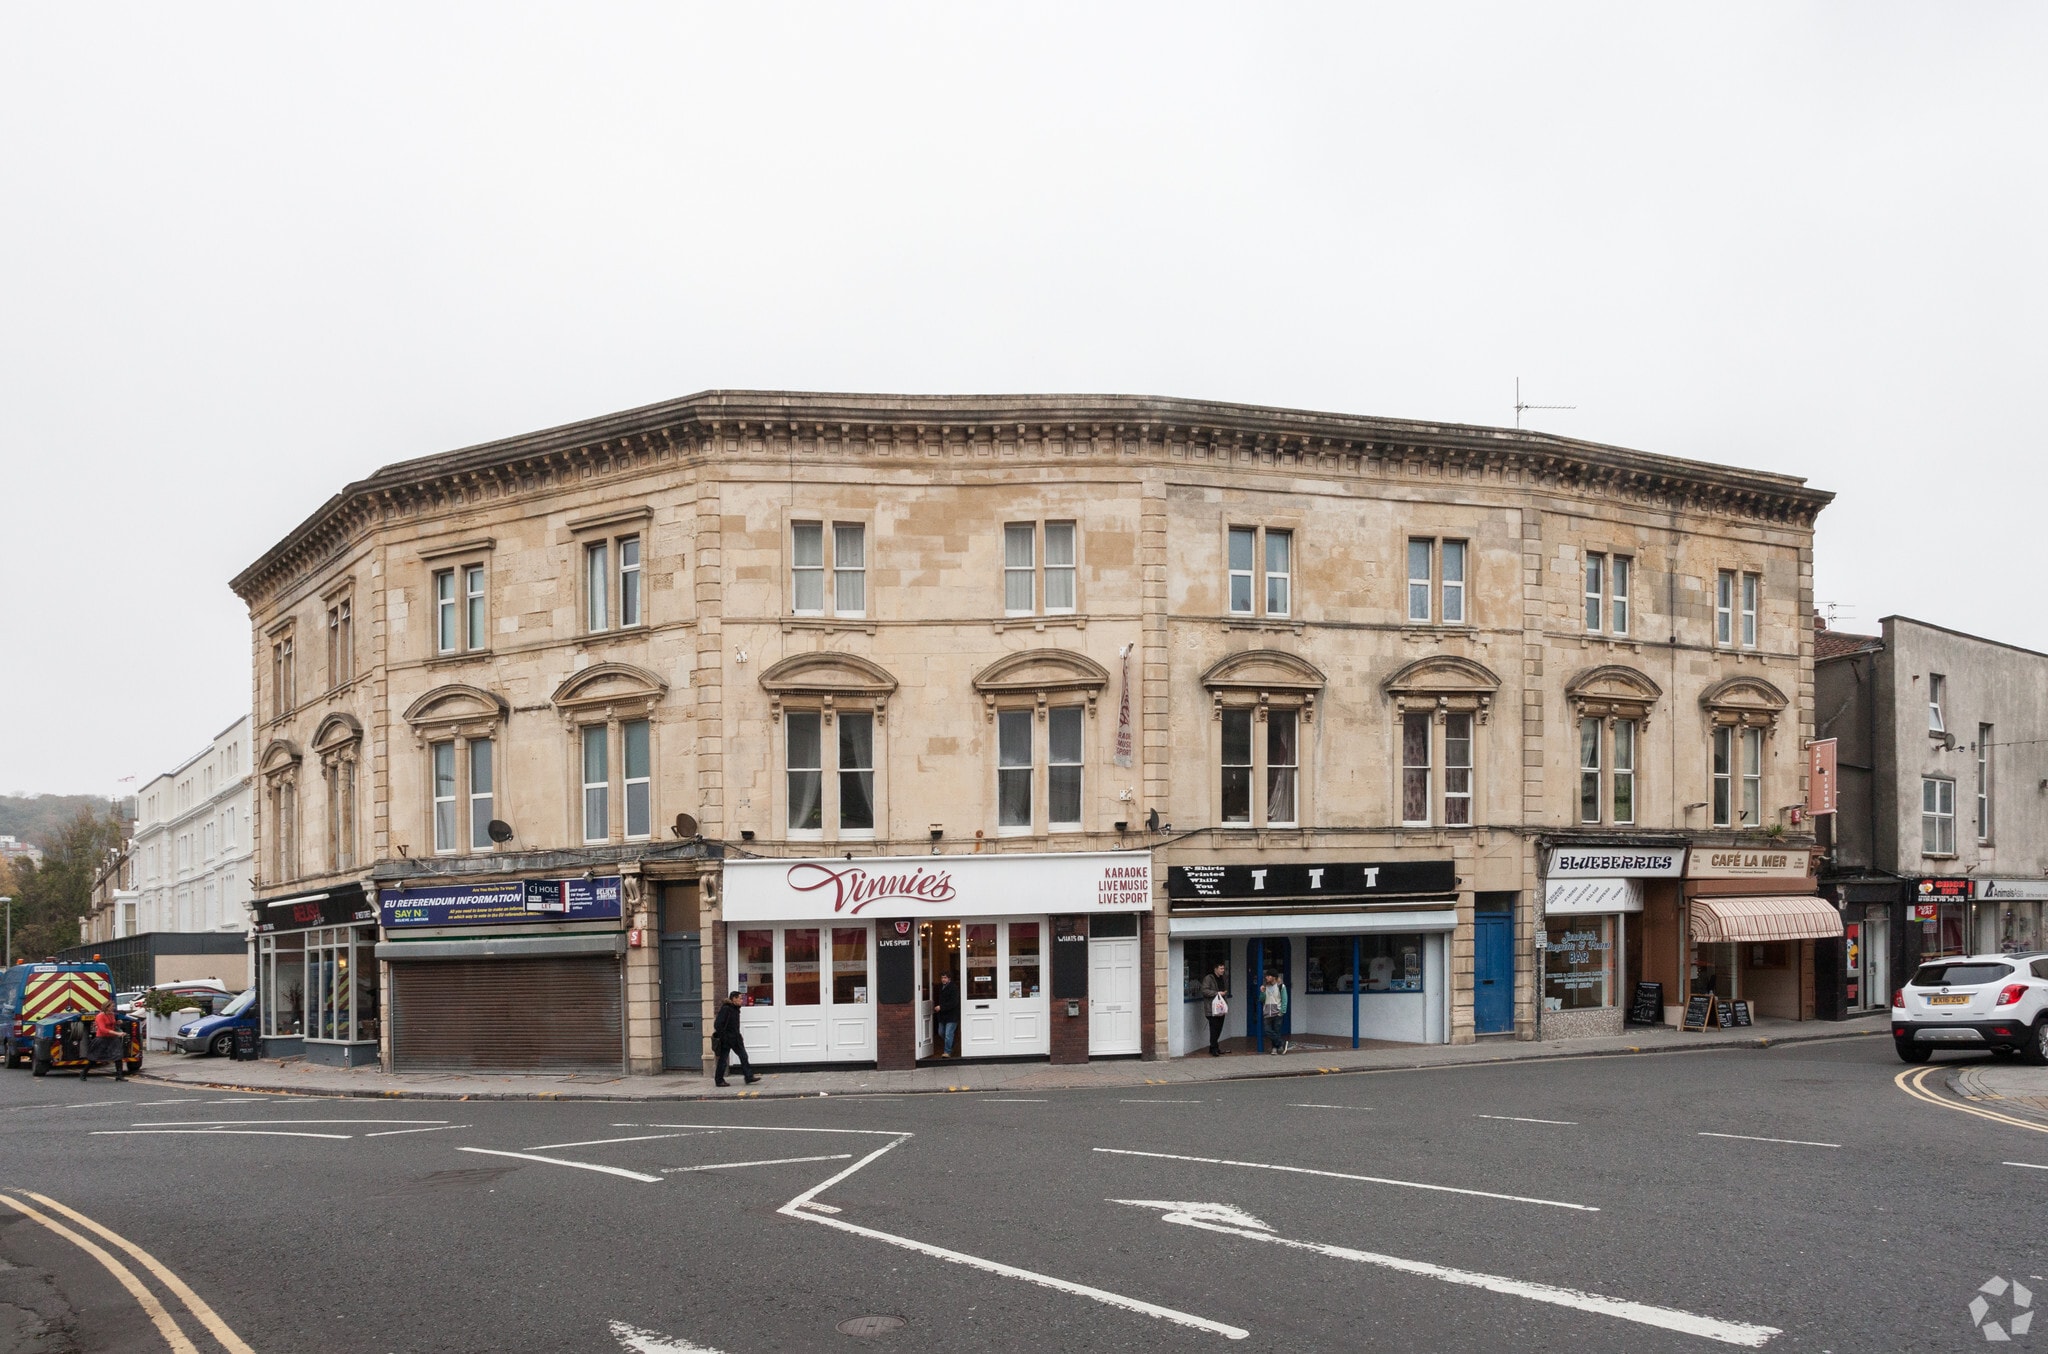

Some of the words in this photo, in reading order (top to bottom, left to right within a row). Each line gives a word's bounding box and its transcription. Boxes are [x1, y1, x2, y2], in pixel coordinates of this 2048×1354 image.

[1559, 856, 1672, 870] BLUEBERRIES
[1711, 852, 1741, 867] CAFÉ
[1744, 854, 1758, 867] LA
[1762, 854, 1787, 868] MER
[1104, 866, 1148, 878] KARAOKE
[787, 863, 956, 914] Vinnie's
[1098, 880, 1118, 891] LIVE
[1120, 880, 1148, 890] MUSIC
[384, 900, 397, 908] EU
[397, 896, 456, 908] REFERENDUM
[456, 893, 522, 905] INFORMATION
[1098, 893, 1118, 904] LIVE
[1120, 892, 1148, 904] SPORT
[394, 909, 412, 918] SAY
[414, 908, 429, 917] NO
[631, 932, 638, 940] S
[1569, 952, 1589, 963] BAR
